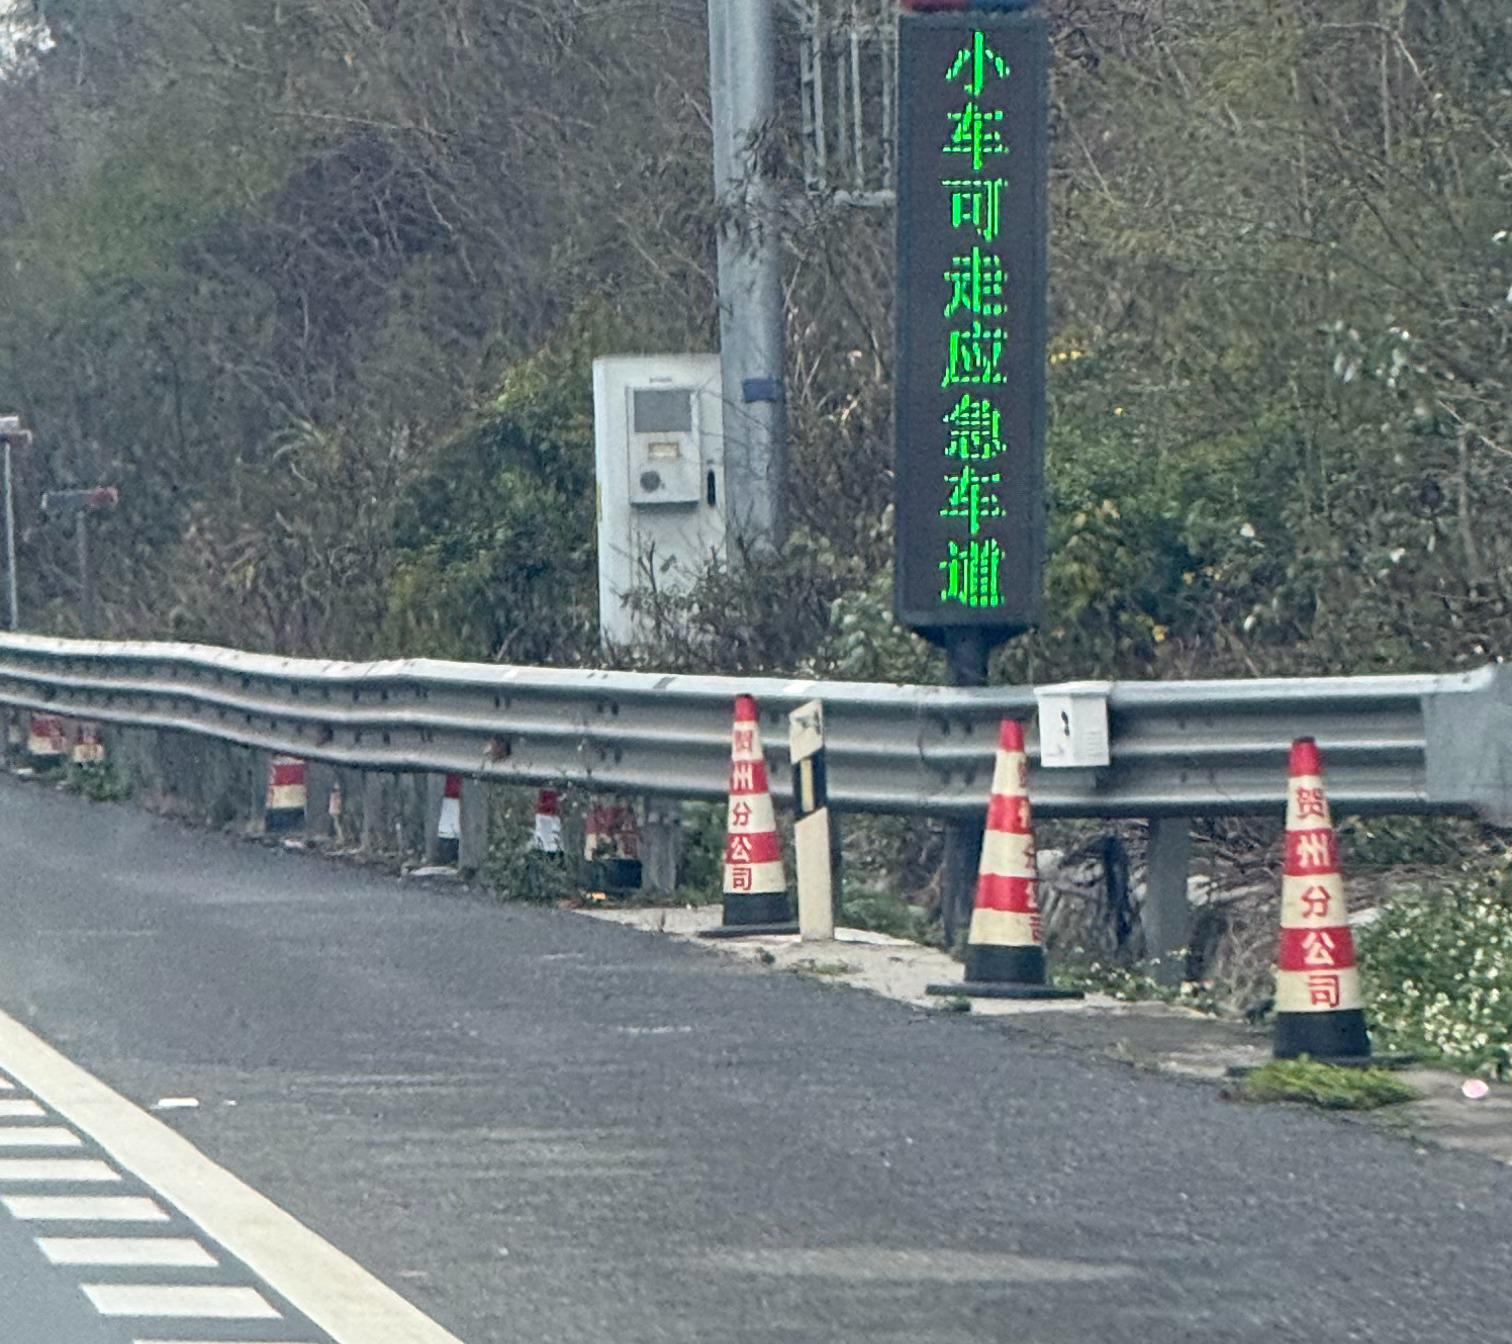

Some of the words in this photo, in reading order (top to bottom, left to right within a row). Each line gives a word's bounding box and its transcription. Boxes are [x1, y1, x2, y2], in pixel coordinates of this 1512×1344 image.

[941, 30, 1009, 607] 小车可走应急车道
